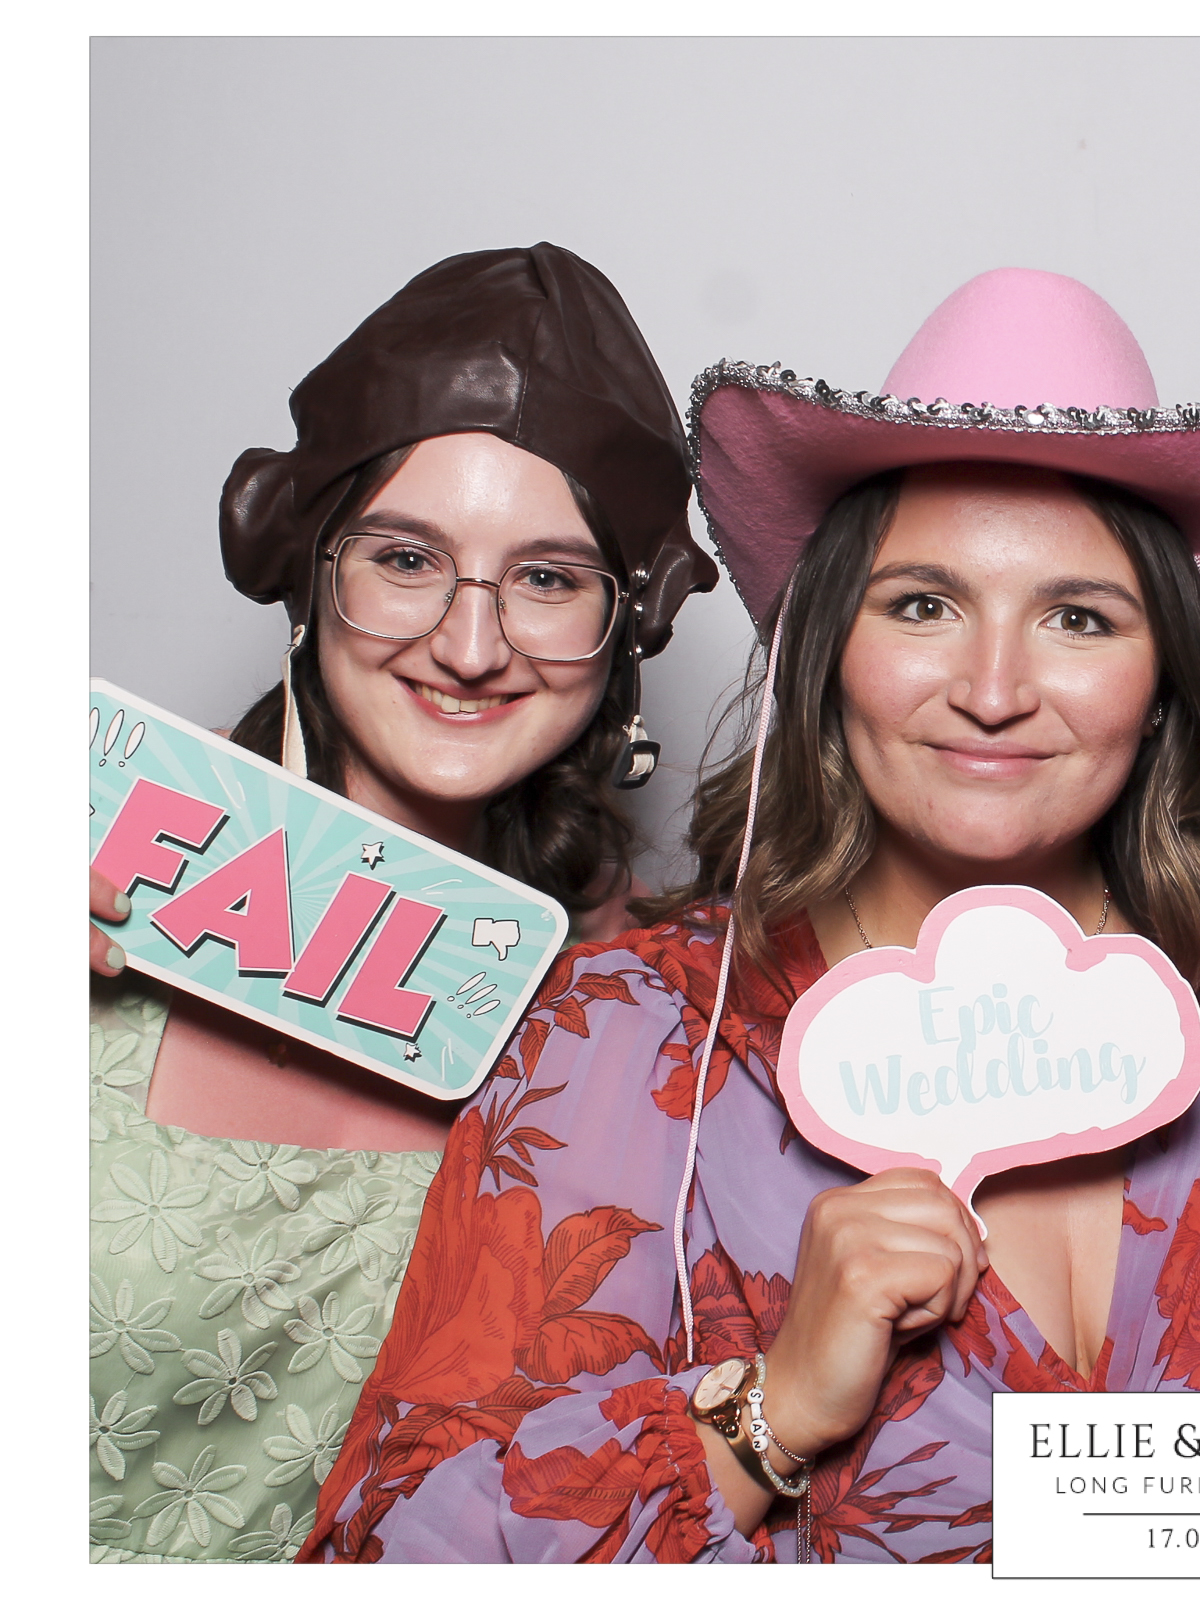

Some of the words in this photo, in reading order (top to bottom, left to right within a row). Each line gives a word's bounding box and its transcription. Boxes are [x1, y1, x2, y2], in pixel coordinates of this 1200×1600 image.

[90, 776, 447, 1042] FAIL
[917, 983, 1054, 1053] Epic
[838, 1032, 1147, 1116] Wedding
